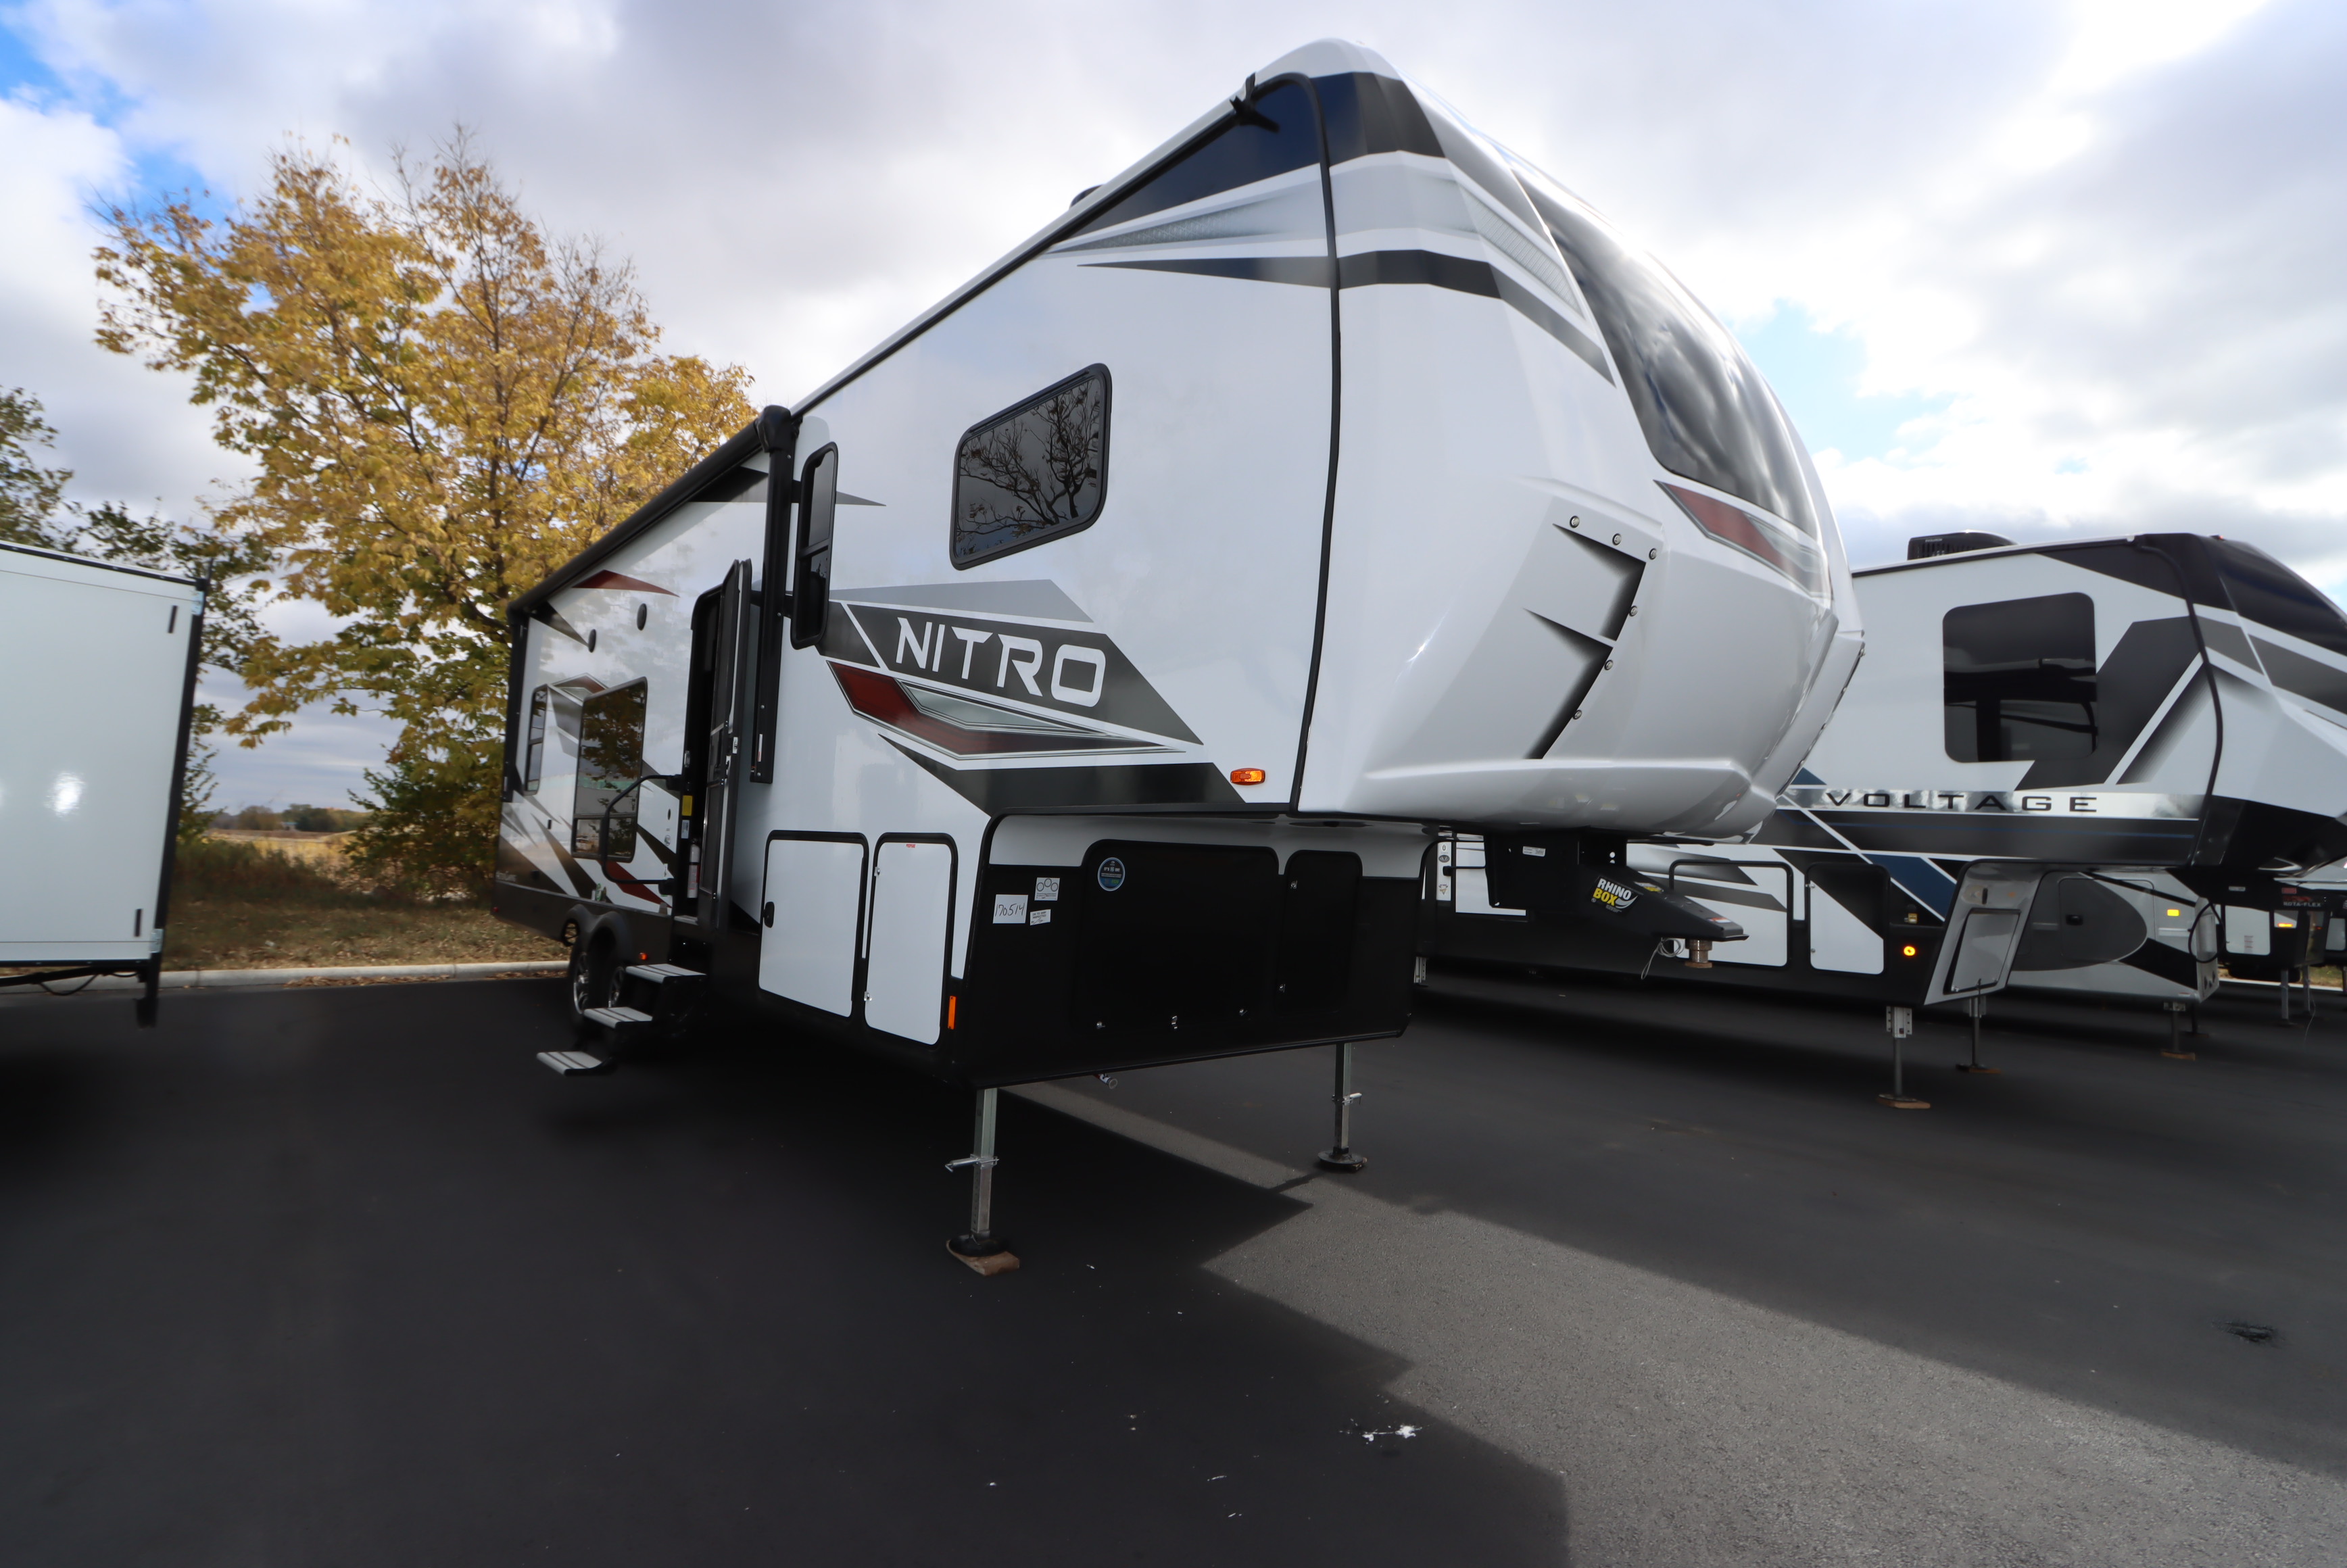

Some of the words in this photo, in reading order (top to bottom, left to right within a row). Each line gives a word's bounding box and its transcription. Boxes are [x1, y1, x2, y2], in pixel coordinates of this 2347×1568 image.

[896, 616, 1107, 708] NITRO
[1826, 792, 2098, 813] VOLTAGE
[1593, 887, 1618, 906] BOX
[1597, 878, 1632, 900] RHINO
[995, 903, 1025, 916] 170514
